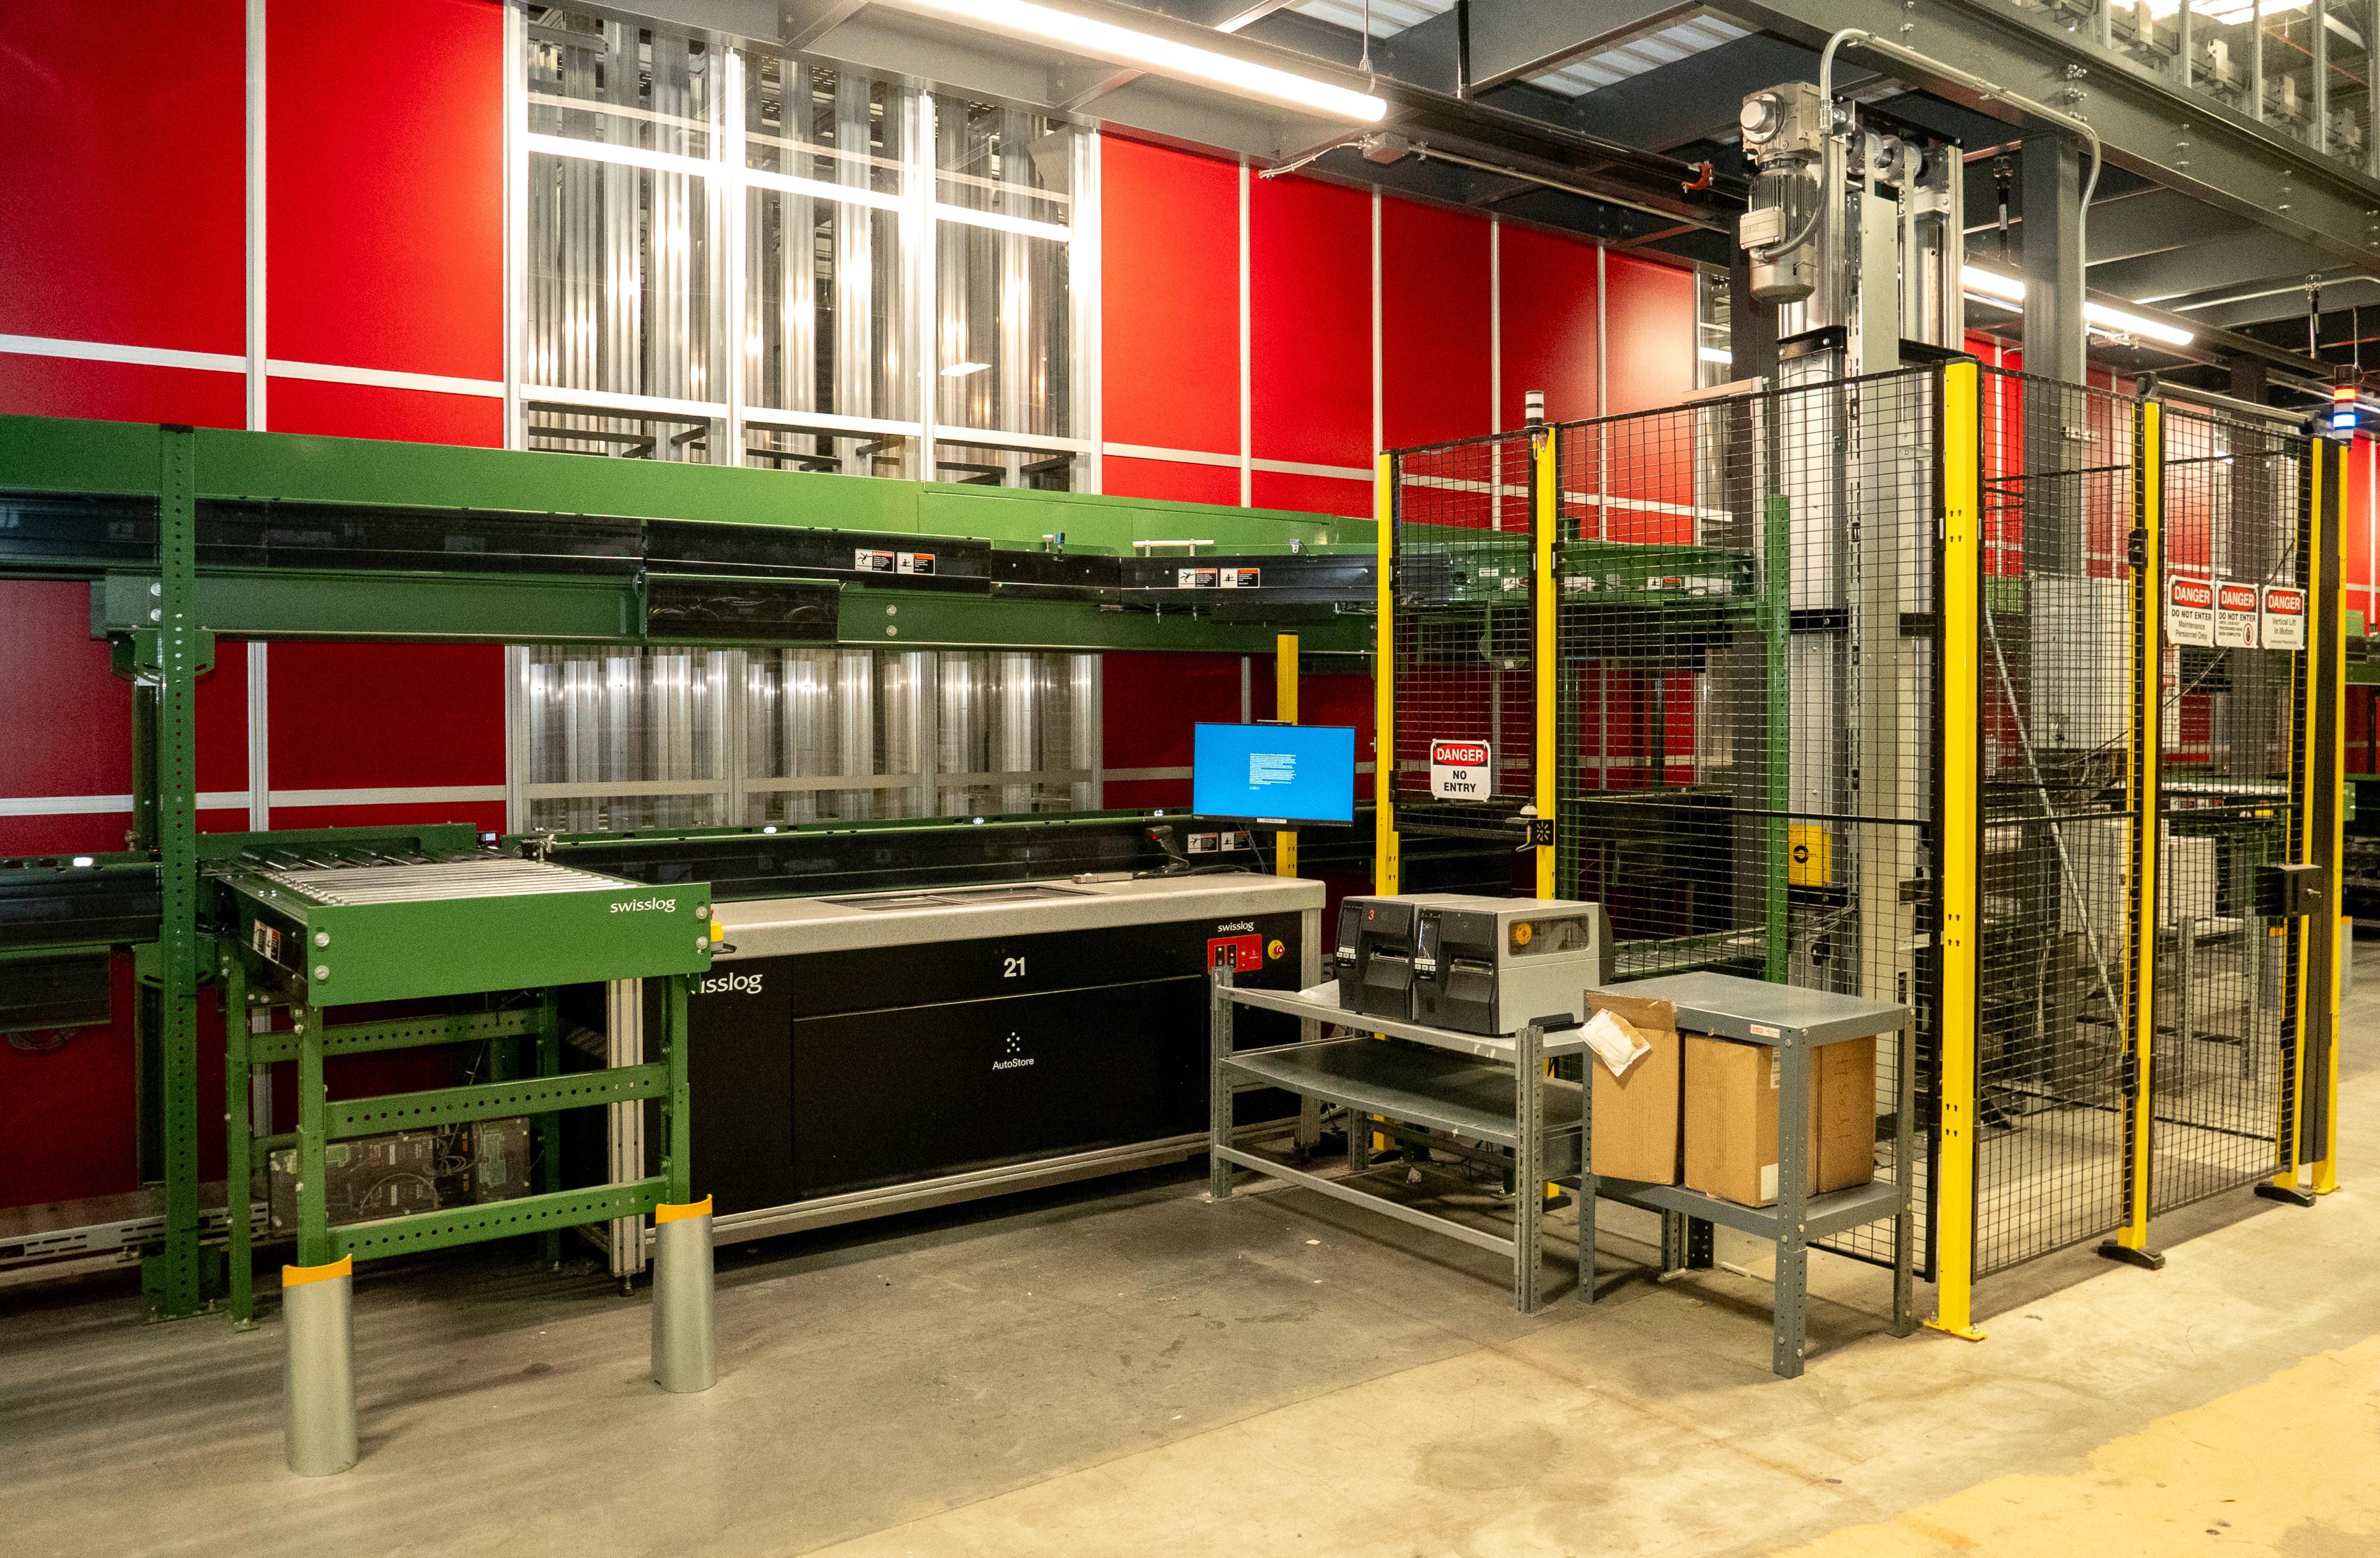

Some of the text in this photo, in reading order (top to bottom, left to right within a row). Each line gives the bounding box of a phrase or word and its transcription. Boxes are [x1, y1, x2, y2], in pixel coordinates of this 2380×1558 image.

[2174, 586, 2210, 604] DANGER
[2221, 591, 2255, 607] DANGER
[2268, 594, 2301, 610] DANGER
[2172, 609, 2212, 621] DO NOT ENTER
[2219, 612, 2256, 622] DO NOT ENTER
[2272, 617, 2288, 625] Vertical
[2179, 620, 2205, 630] Maintenance
[2280, 627, 2294, 635] Motion
[2175, 629, 2208, 641] Personnel Only
[1437, 748, 1484, 762] DANGER
[1453, 770, 1467, 780] NO
[1443, 782, 1476, 793] ENTRY
[610, 897, 676, 913] swisslog
[1368, 909, 1375, 921] 3
[1217, 921, 1254, 932] swisslog
[1003, 957, 1025, 977] 21
[691, 972, 763, 994] isslog
[992, 1058, 1034, 1070] AutoStore
